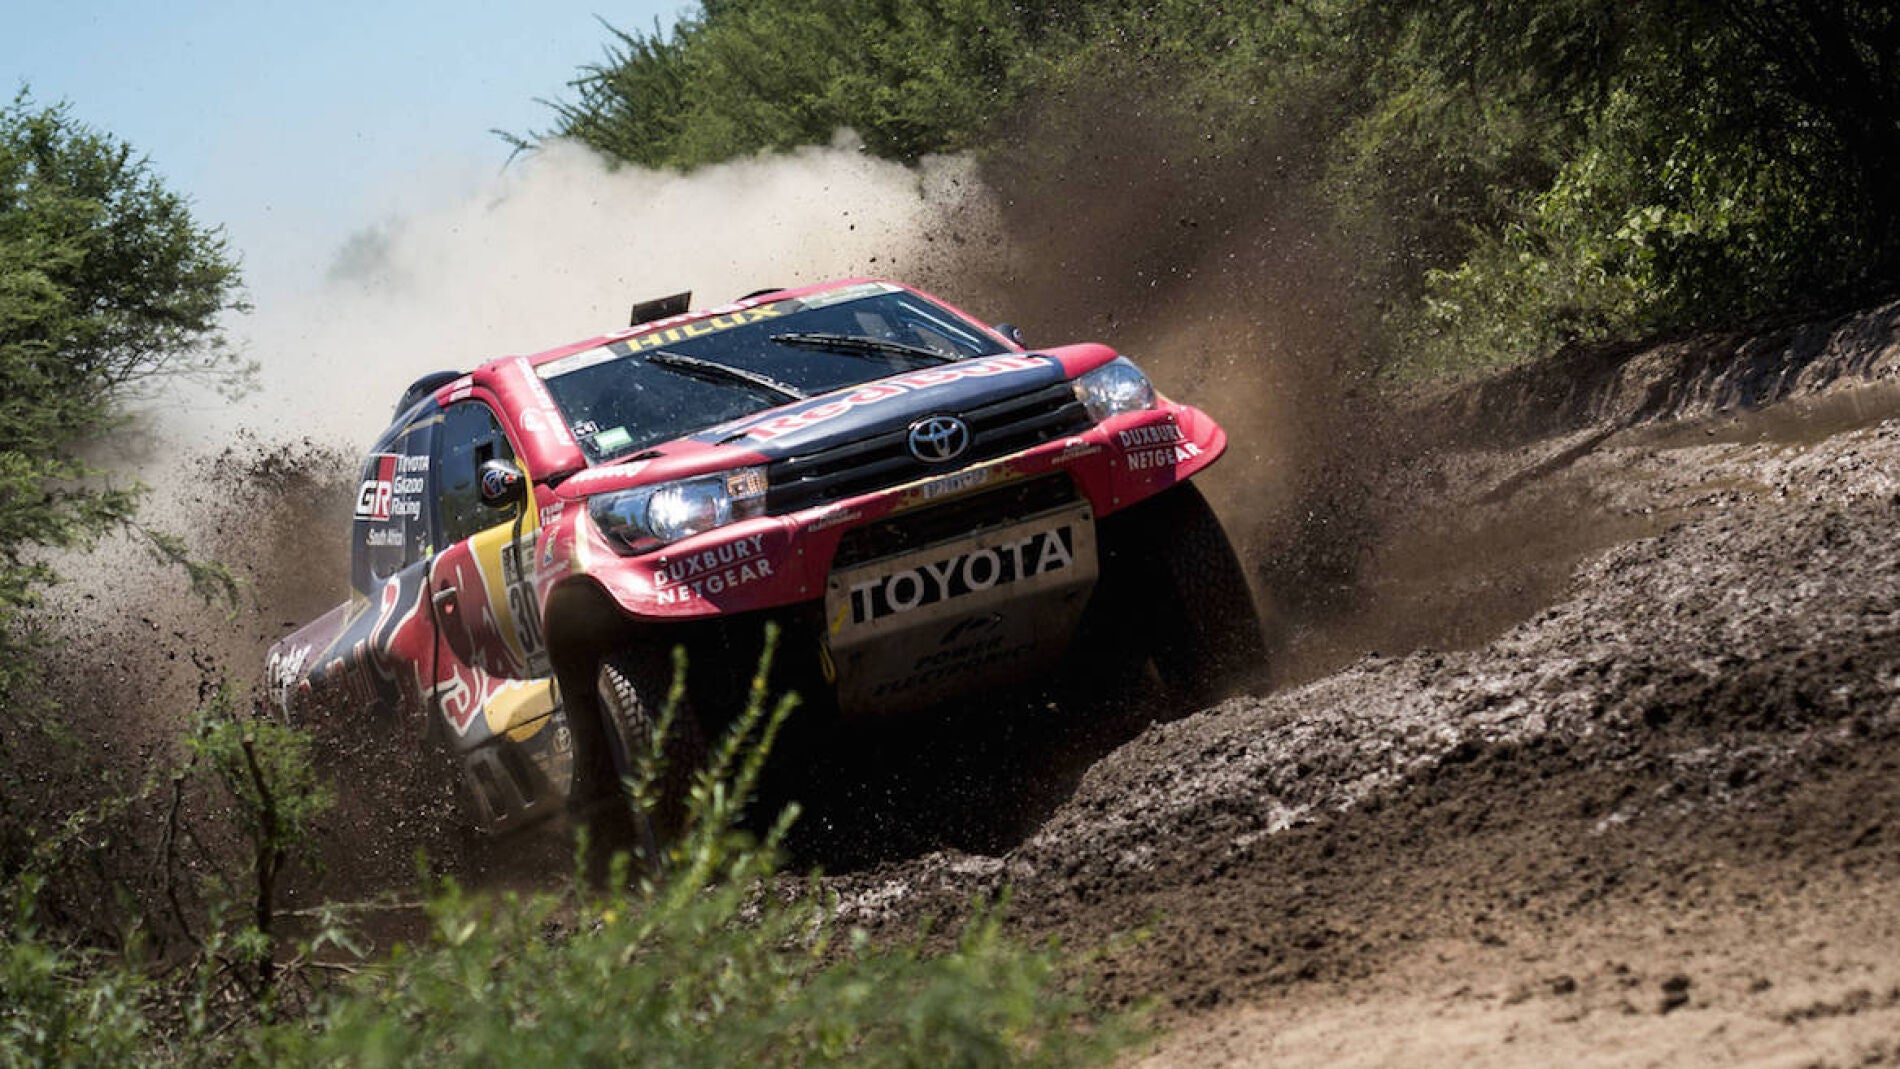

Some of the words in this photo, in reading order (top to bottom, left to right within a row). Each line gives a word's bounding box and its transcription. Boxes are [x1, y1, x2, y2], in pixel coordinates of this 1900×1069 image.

[626, 303, 782, 351] HILUX
[1118, 425, 1185, 447] DUXBURY
[1127, 442, 1204, 471] NETGEAR
[355, 480, 393, 516] GR
[391, 496, 421, 521] Racing
[654, 534, 764, 588] DUXBURY
[656, 558, 774, 606] NETGEAR
[850, 530, 1073, 622] TOYOTA
